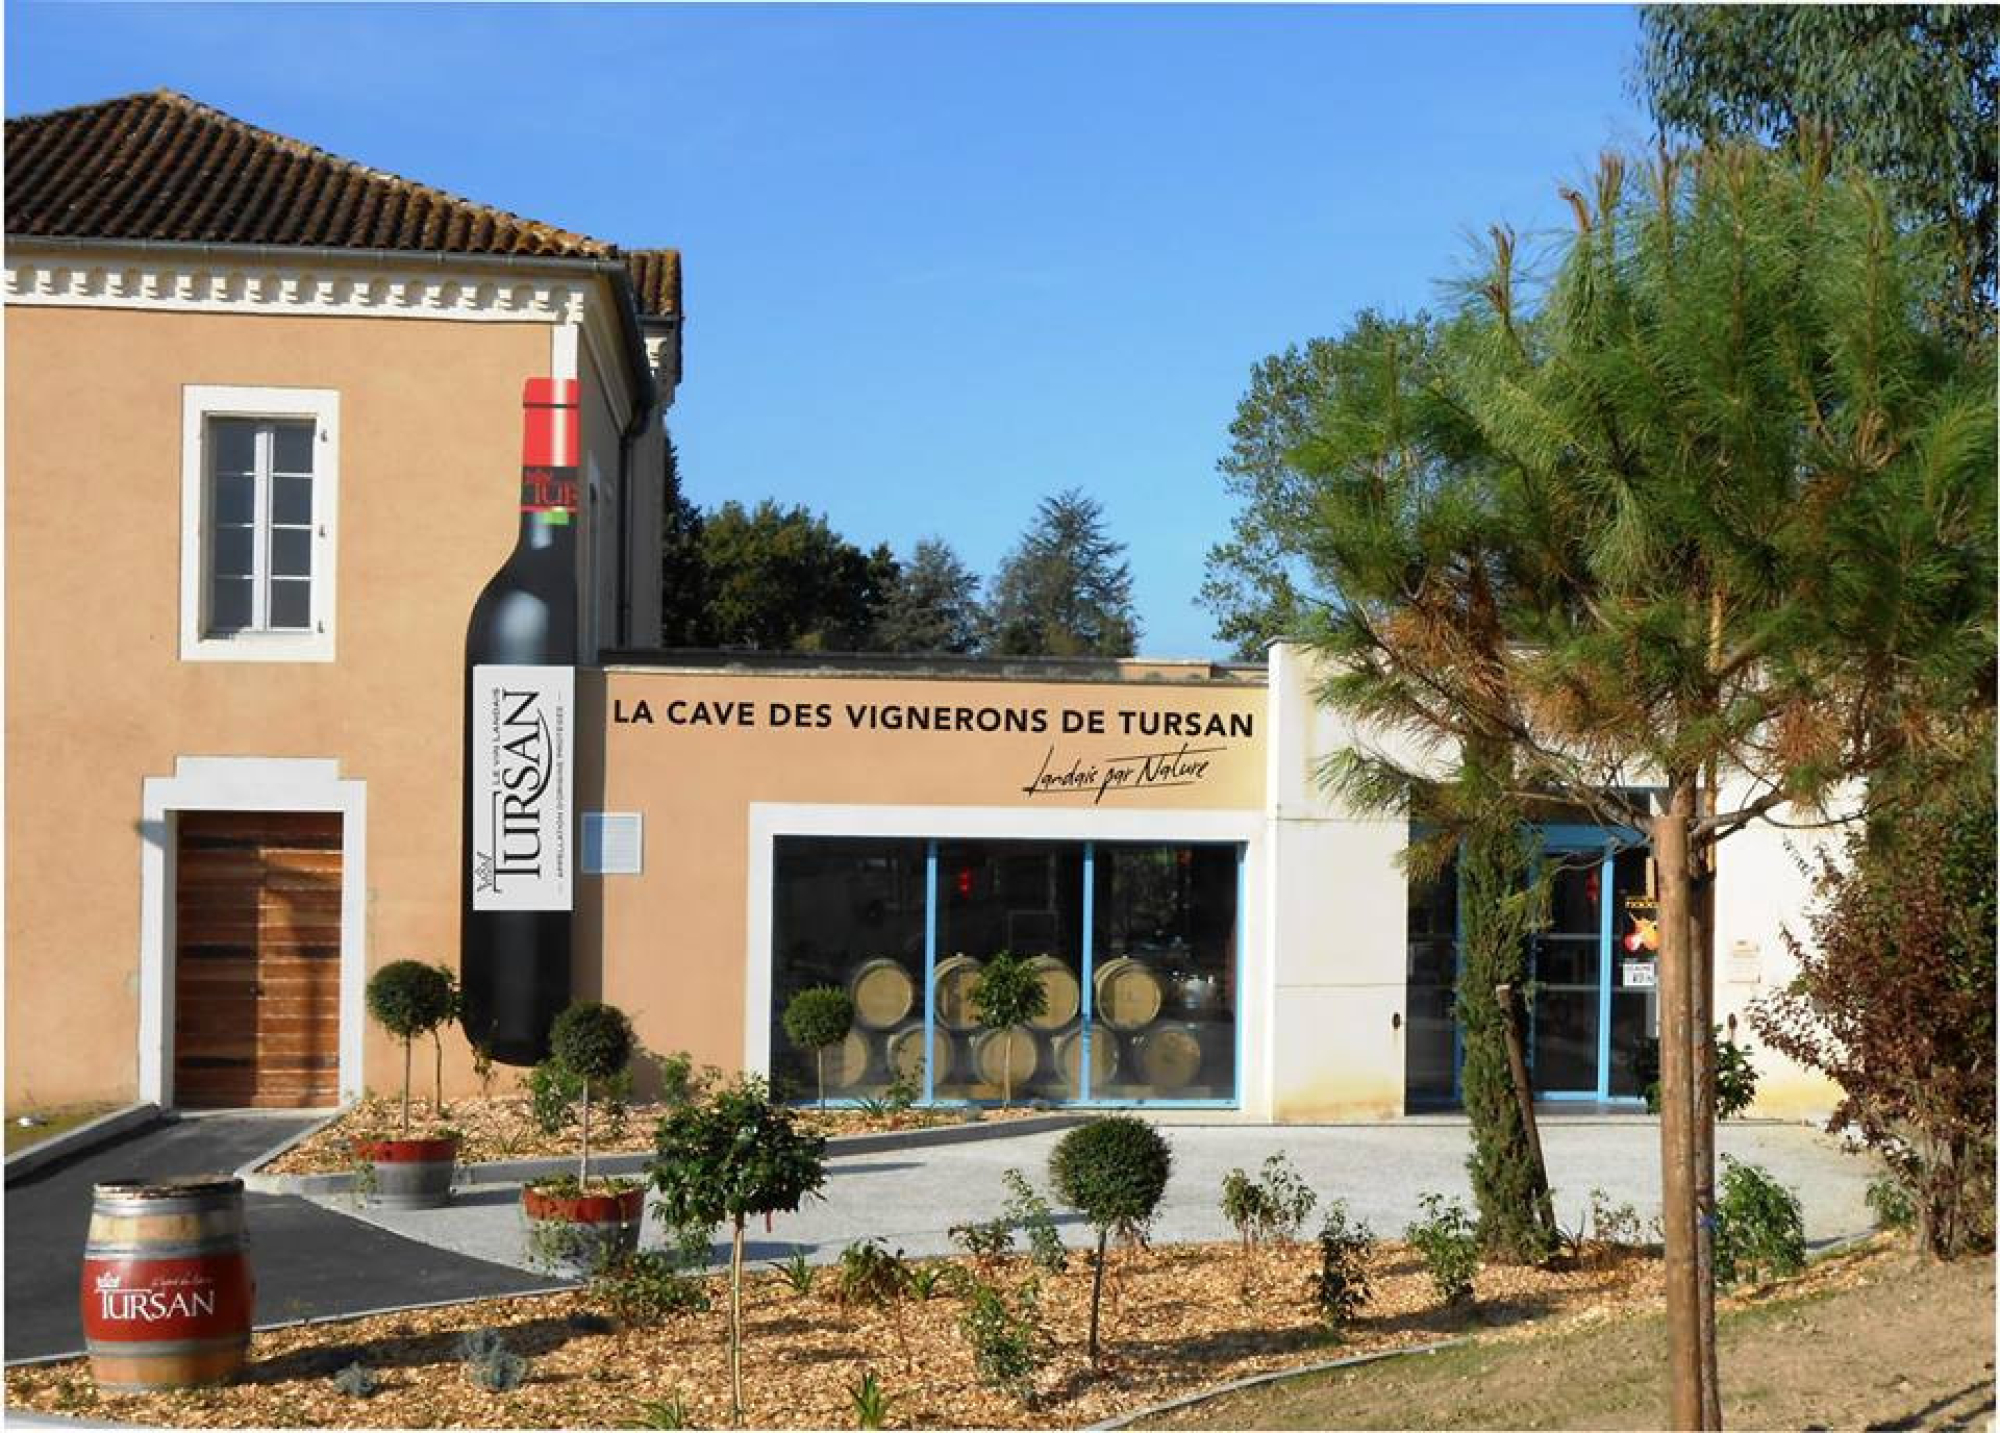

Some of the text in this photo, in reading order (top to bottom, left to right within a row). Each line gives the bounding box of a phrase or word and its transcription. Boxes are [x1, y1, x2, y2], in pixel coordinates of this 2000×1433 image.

[492, 688, 501, 786] LE VIN LANDAIS
[613, 699, 1253, 738] LA CAVE DES VIGNERONS DE TURSAN
[493, 688, 553, 895] TURSAN
[1023, 742, 1210, 804] Landais par Nature
[555, 813, 564, 878] APPELLATION
[94, 1287, 215, 1322] TURSAN
